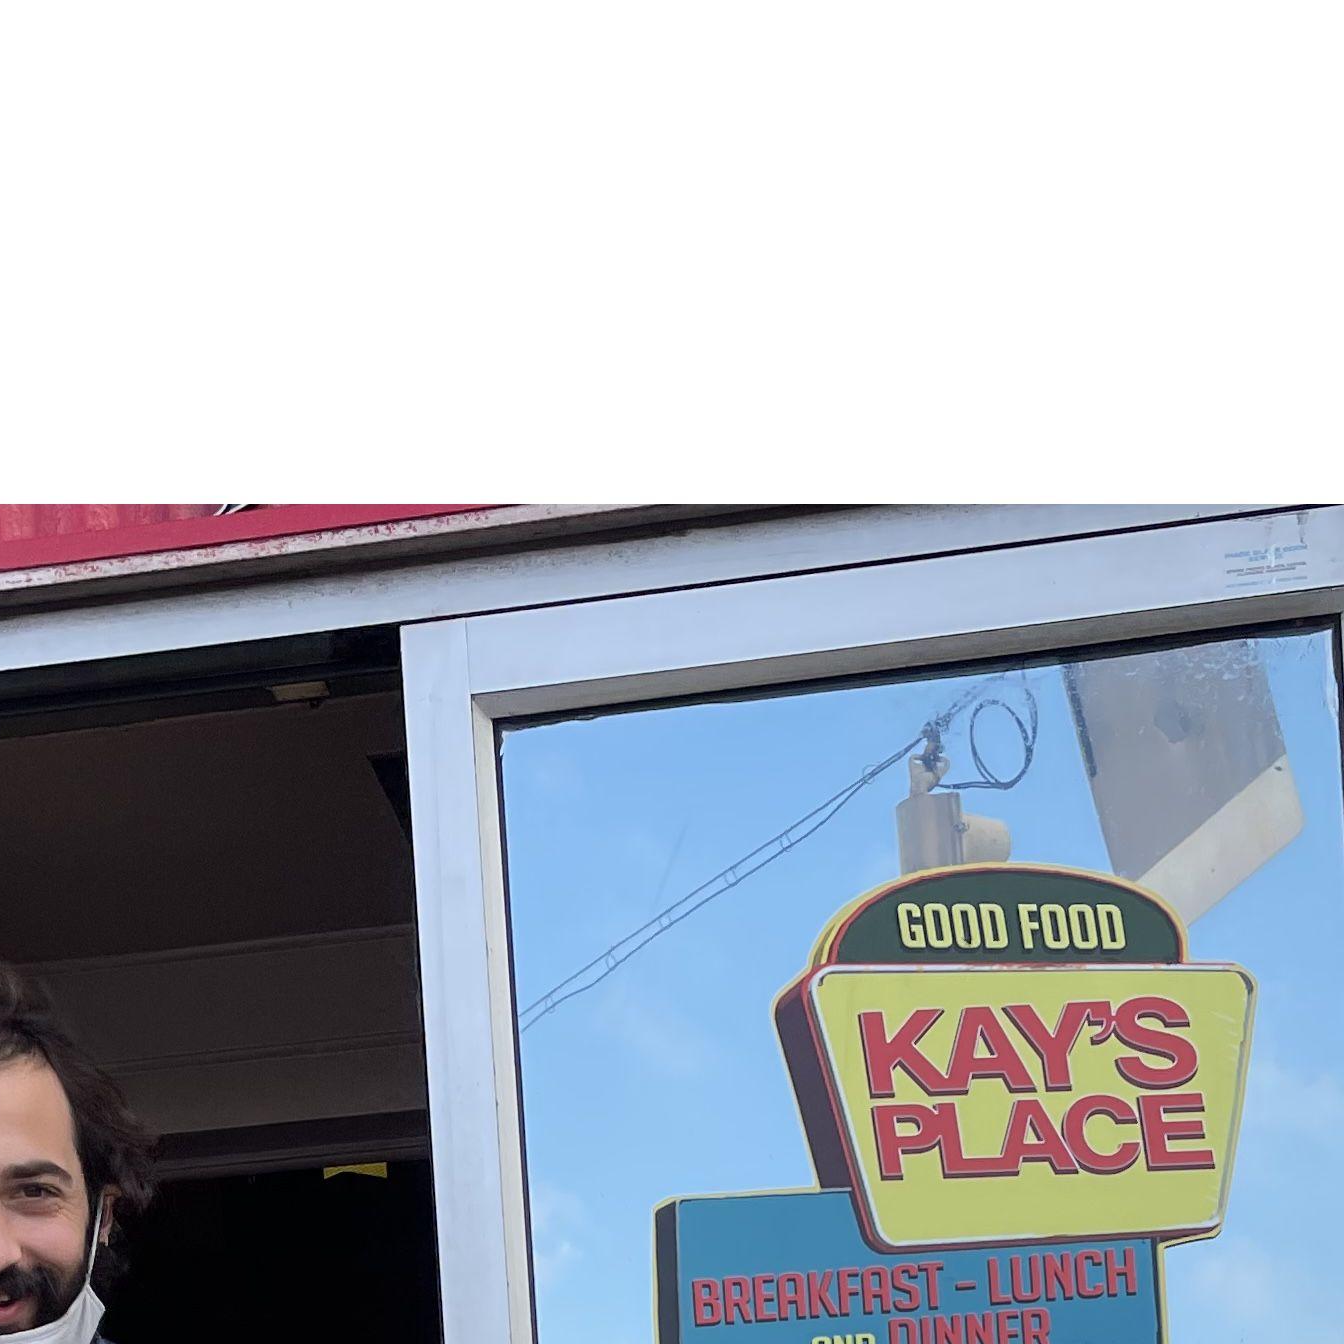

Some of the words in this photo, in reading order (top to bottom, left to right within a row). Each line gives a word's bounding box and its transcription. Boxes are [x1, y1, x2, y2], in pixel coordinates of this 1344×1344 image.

[897, 902, 1008, 950] GOOD
[1017, 903, 1127, 951] FOOD
[858, 996, 1199, 1099] KAY'S
[871, 1091, 1216, 1180] PLACE
[691, 1261, 944, 1328] BREAKFAST
[987, 1247, 1138, 1304] LUNCH
